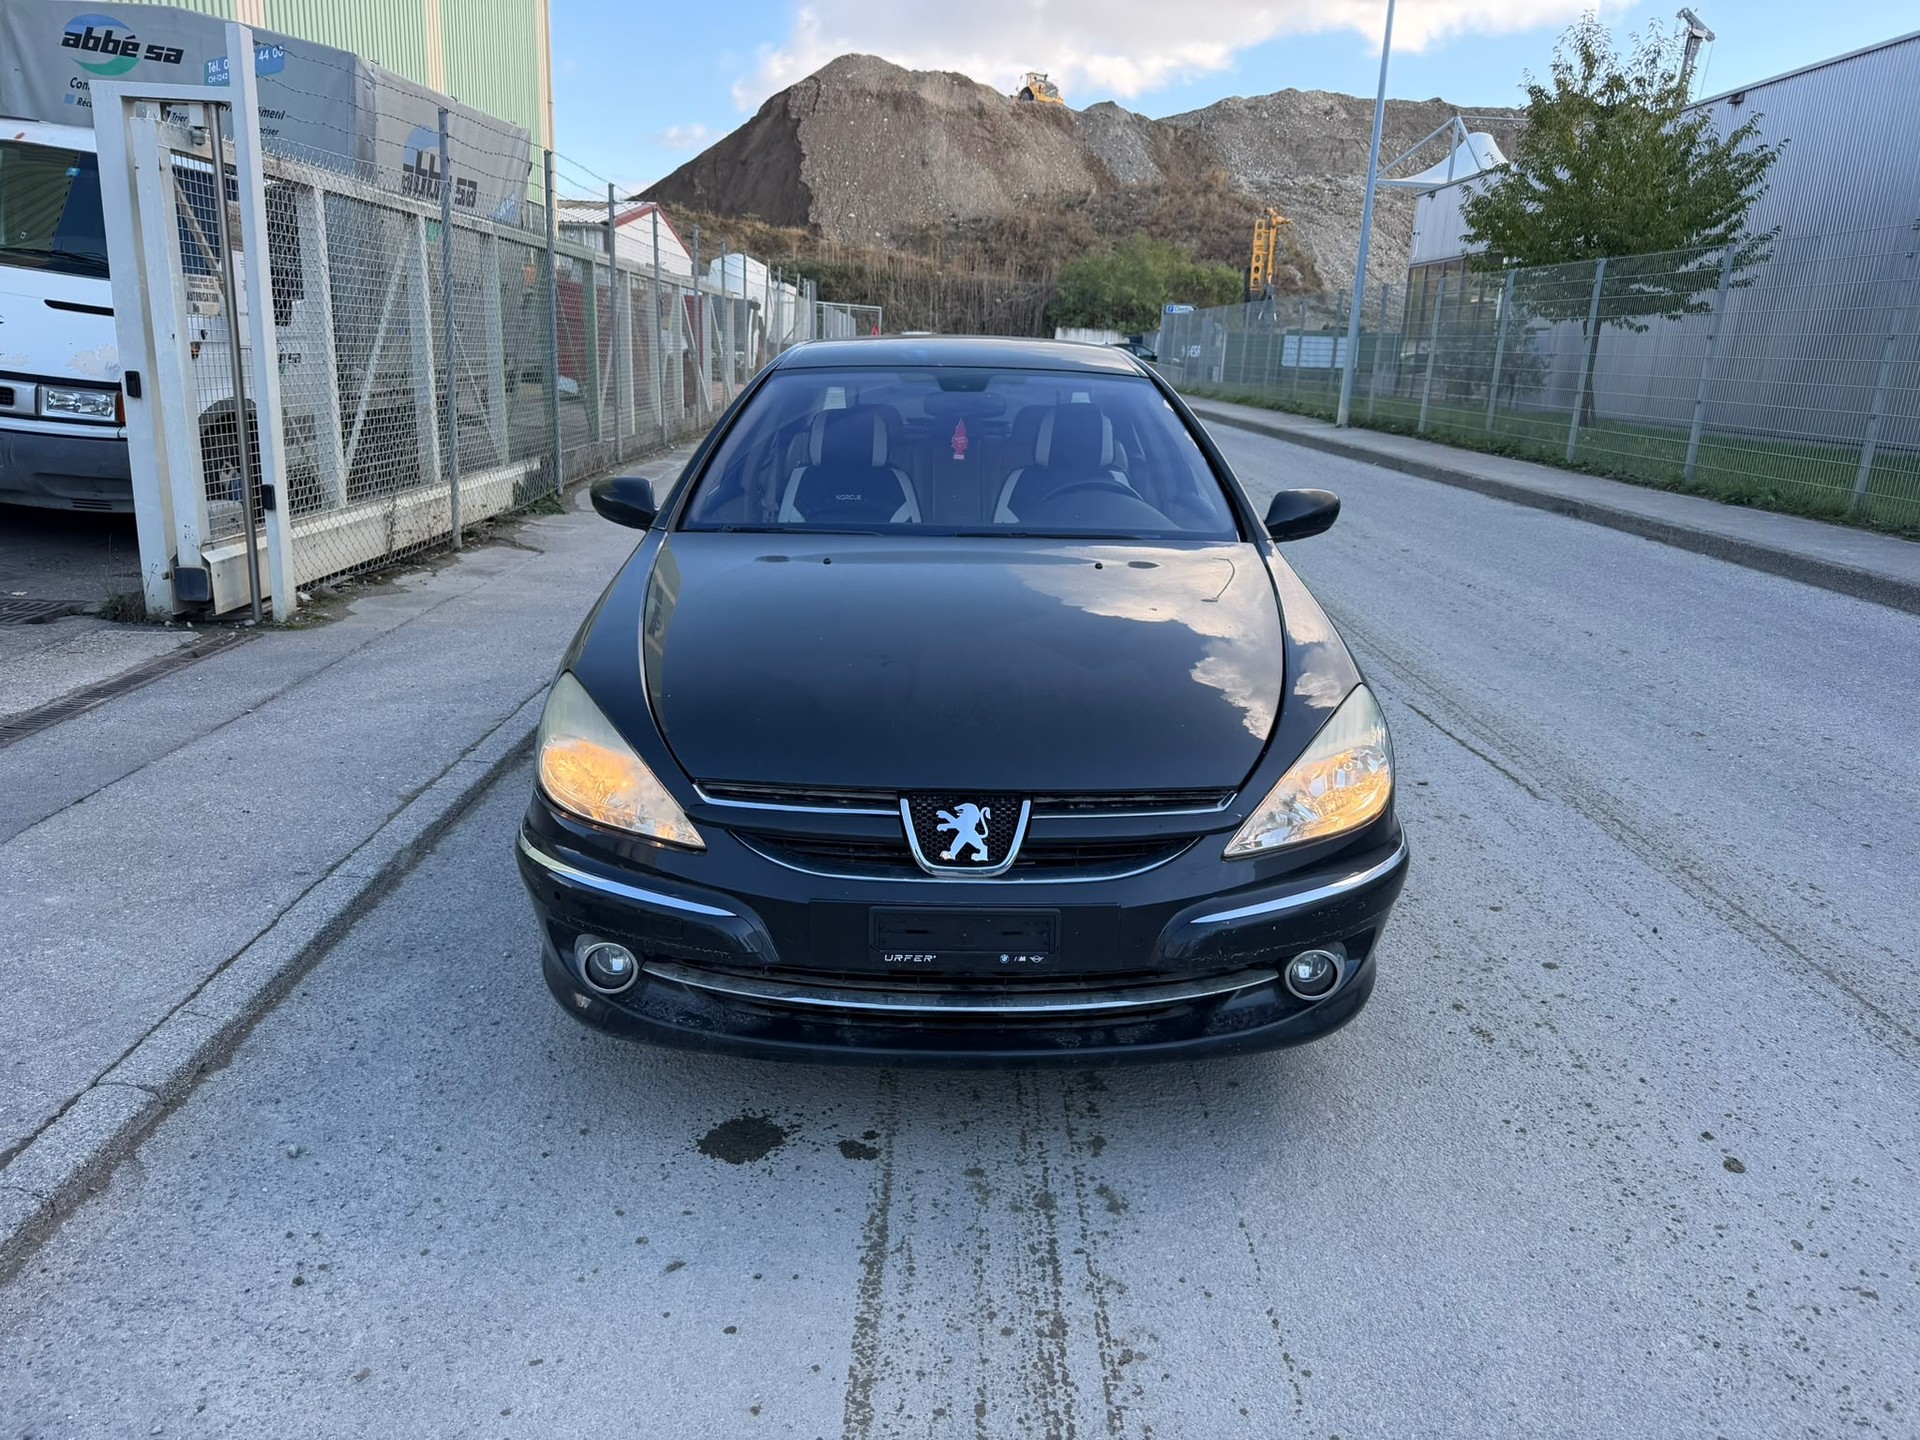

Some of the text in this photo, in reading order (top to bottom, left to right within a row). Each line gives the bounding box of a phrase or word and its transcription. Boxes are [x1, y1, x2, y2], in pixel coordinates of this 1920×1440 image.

[61, 27, 184, 65] abbé sa
[207, 60, 221, 73] Tél.
[258, 49, 269, 61] 44
[69, 77, 91, 91] Con
[186, 290, 220, 303] AUTORISATION
[884, 954, 933, 962] URFER
